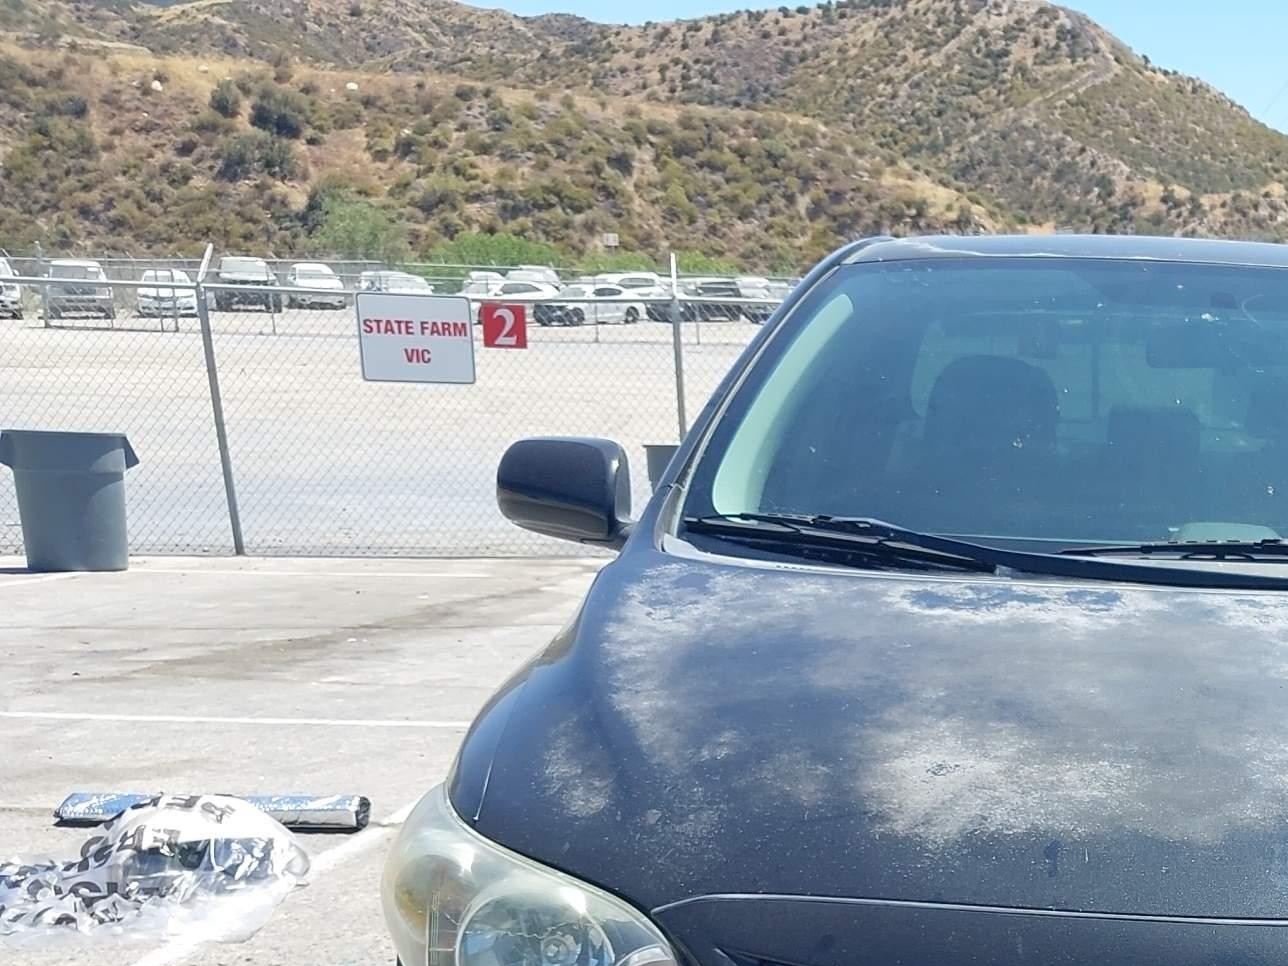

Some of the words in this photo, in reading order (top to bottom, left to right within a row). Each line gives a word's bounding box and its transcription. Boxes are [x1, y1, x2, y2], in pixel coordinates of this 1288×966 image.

[363, 318, 415, 335] STATE
[420, 321, 468, 337] FARM
[492, 308, 517, 346] 2
[404, 348, 432, 364] VIC
